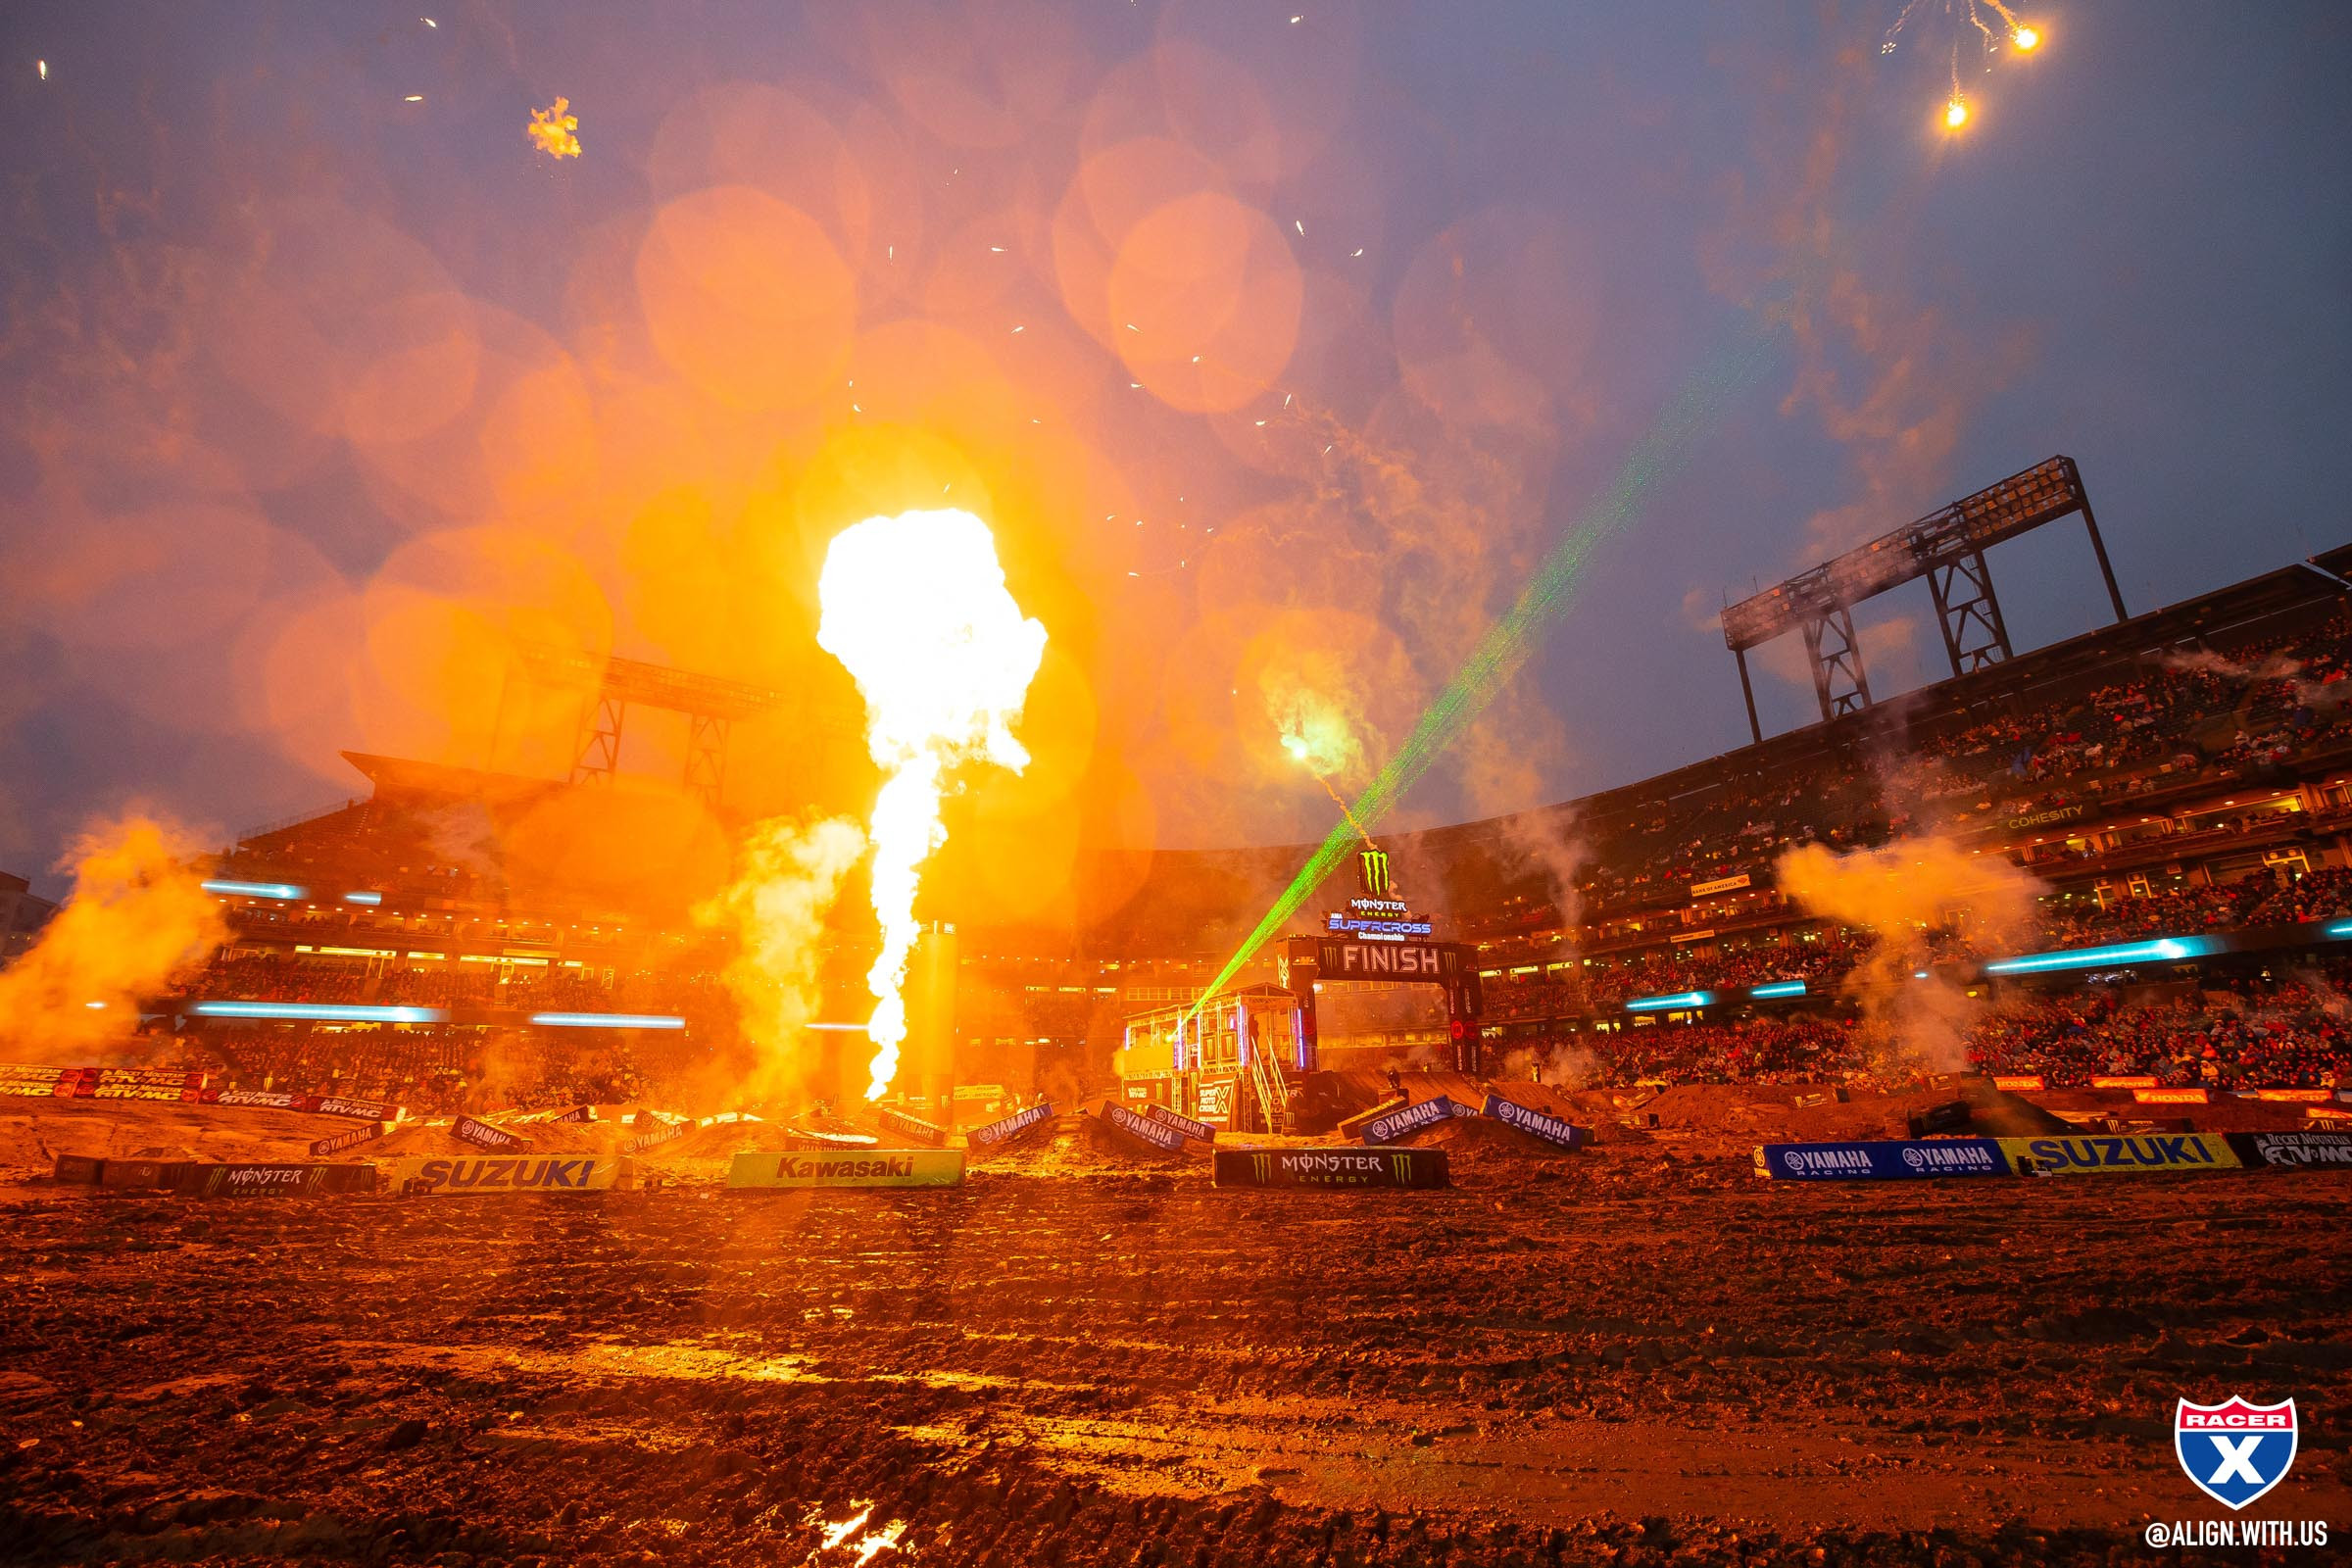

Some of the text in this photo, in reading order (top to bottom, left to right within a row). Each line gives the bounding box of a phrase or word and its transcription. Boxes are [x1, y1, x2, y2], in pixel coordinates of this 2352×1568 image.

[2008, 805, 2083, 829] COHESITY
[1350, 899, 1407, 911] MONSTER
[1329, 919, 1431, 934] SUPERCROSS
[1357, 931, 1405, 941] Championship
[1343, 945, 1440, 974] FINISH
[991, 1106, 1041, 1136] YAMAHA
[1166, 1112, 1205, 1137] YAMAHA
[1386, 1101, 1440, 1131] YAMAHA
[1515, 1107, 1571, 1141] YAMAHA
[329, 1127, 372, 1151] YAMAHA
[472, 1123, 512, 1146] YAMAHA
[637, 1124, 683, 1148] YAMAHA
[899, 1118, 935, 1141] YAMAHA
[1125, 1112, 1173, 1145] YAMAHA
[1502, 1117, 1565, 1146] RACING
[2266, 1133, 2351, 1145] ROCKY MOUNTAIN
[1281, 1153, 1383, 1173] MONSTER
[1801, 1150, 1873, 1168] YAMAHA
[1920, 1147, 1993, 1165] YAMAHA
[2030, 1136, 2215, 1168] SUZUKI
[227, 1167, 304, 1185] MONSTER
[419, 1159, 596, 1188] SUZUKI
[776, 1155, 915, 1179] Kawasaki
[232, 1187, 285, 1196] ENERGY
